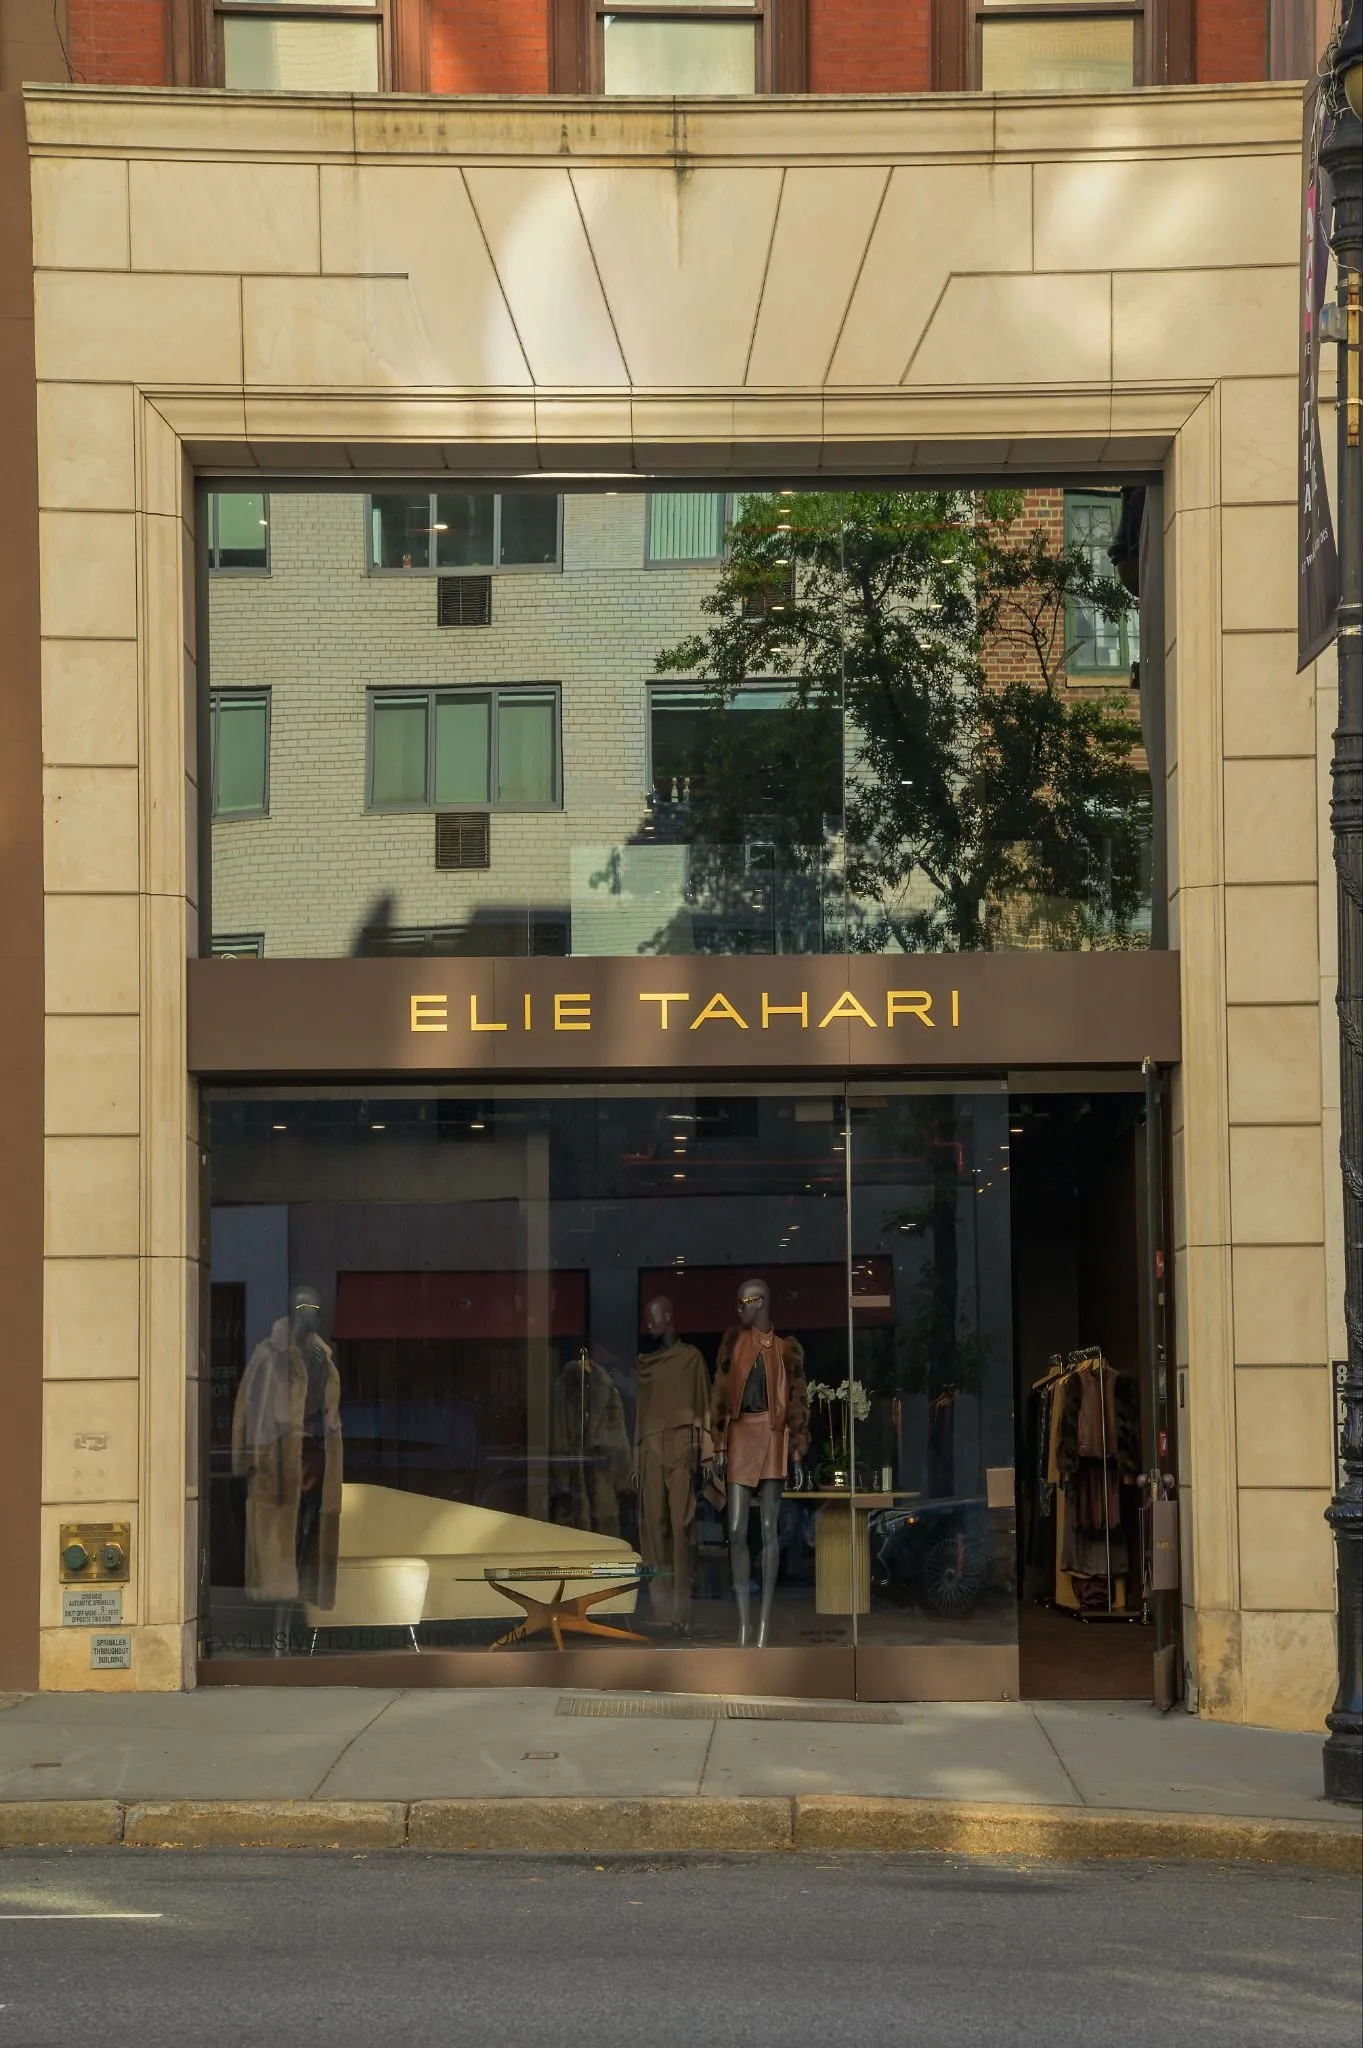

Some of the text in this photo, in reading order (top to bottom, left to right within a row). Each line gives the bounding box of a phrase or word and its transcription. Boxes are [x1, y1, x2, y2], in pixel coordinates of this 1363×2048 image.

[410, 990, 959, 1032] ELIE TAHARI
[326, 1630, 352, 1649] TO
[94, 1647, 129, 1655] THROUGHOUT
[98, 1656, 124, 1664] BUILDING
